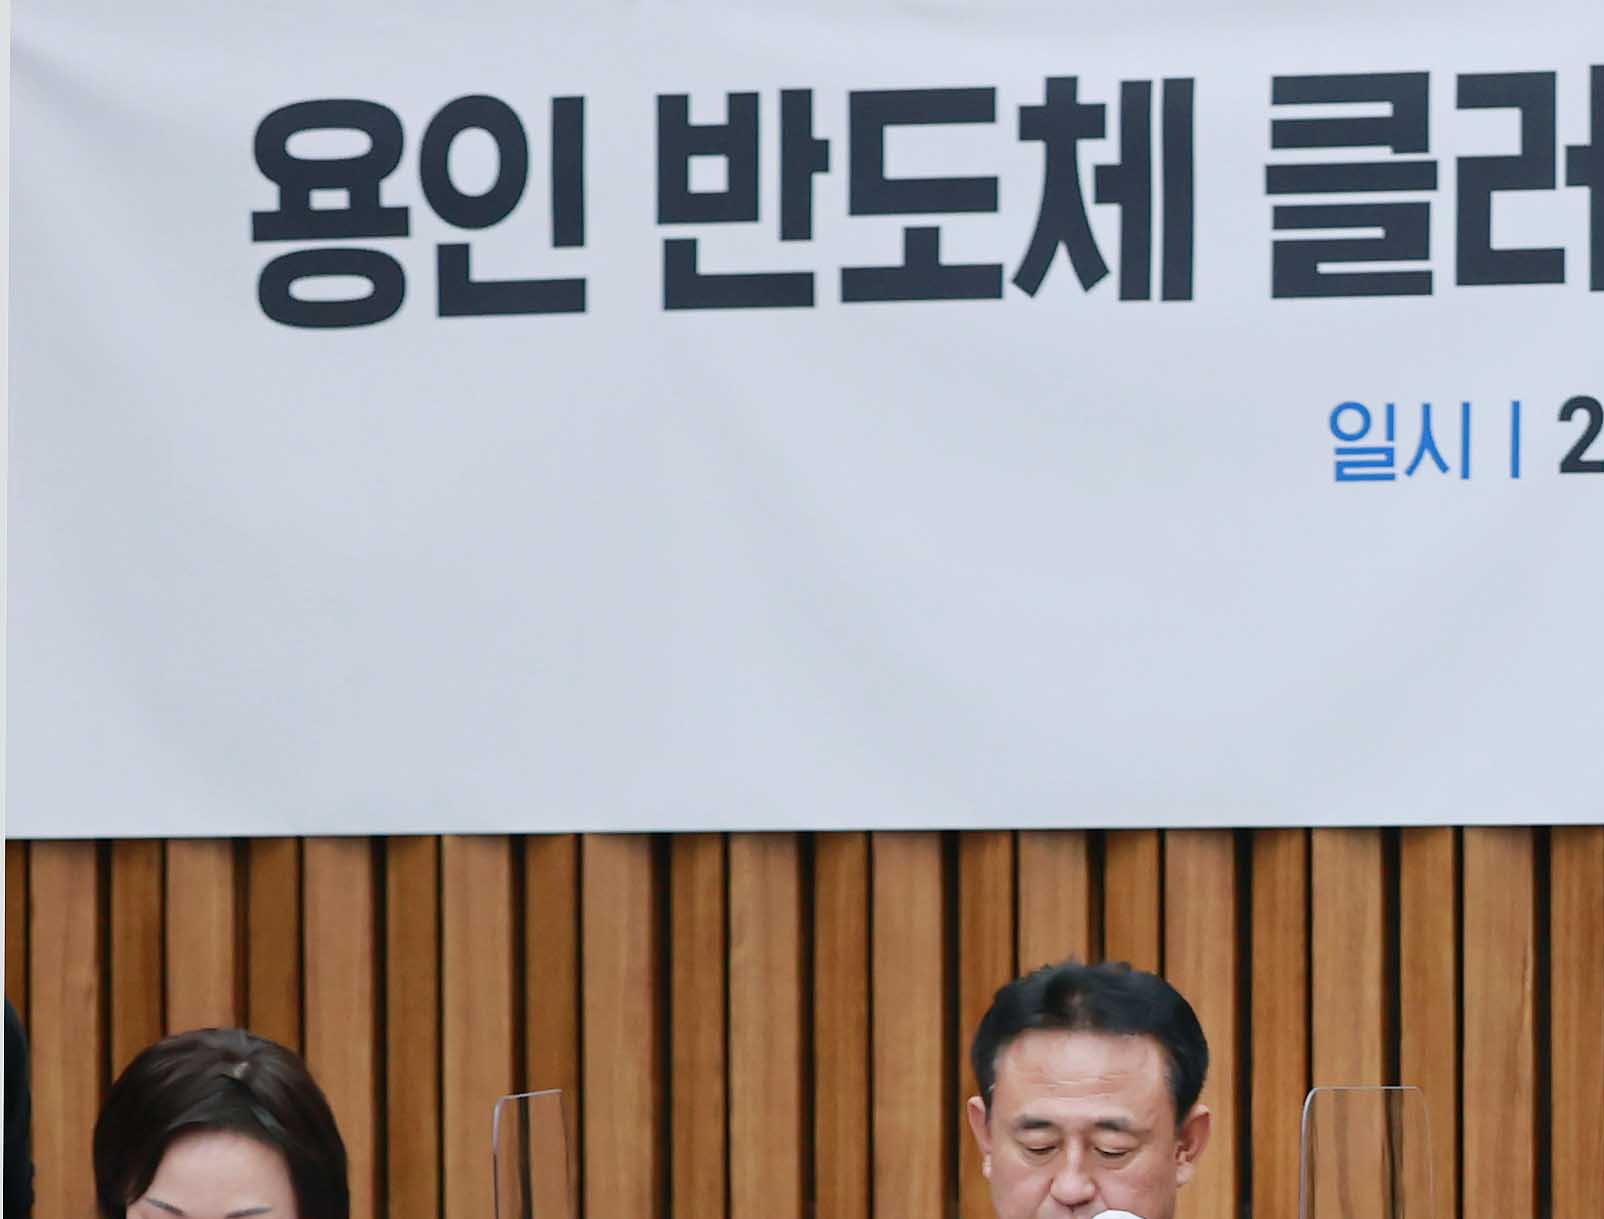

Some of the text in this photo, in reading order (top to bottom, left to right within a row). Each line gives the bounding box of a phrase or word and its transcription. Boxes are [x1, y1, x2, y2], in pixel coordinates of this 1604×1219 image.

[247, 92, 591, 333] 용인
[653, 73, 1198, 314] 반도체
[1328, 400, 1473, 484] 일시
